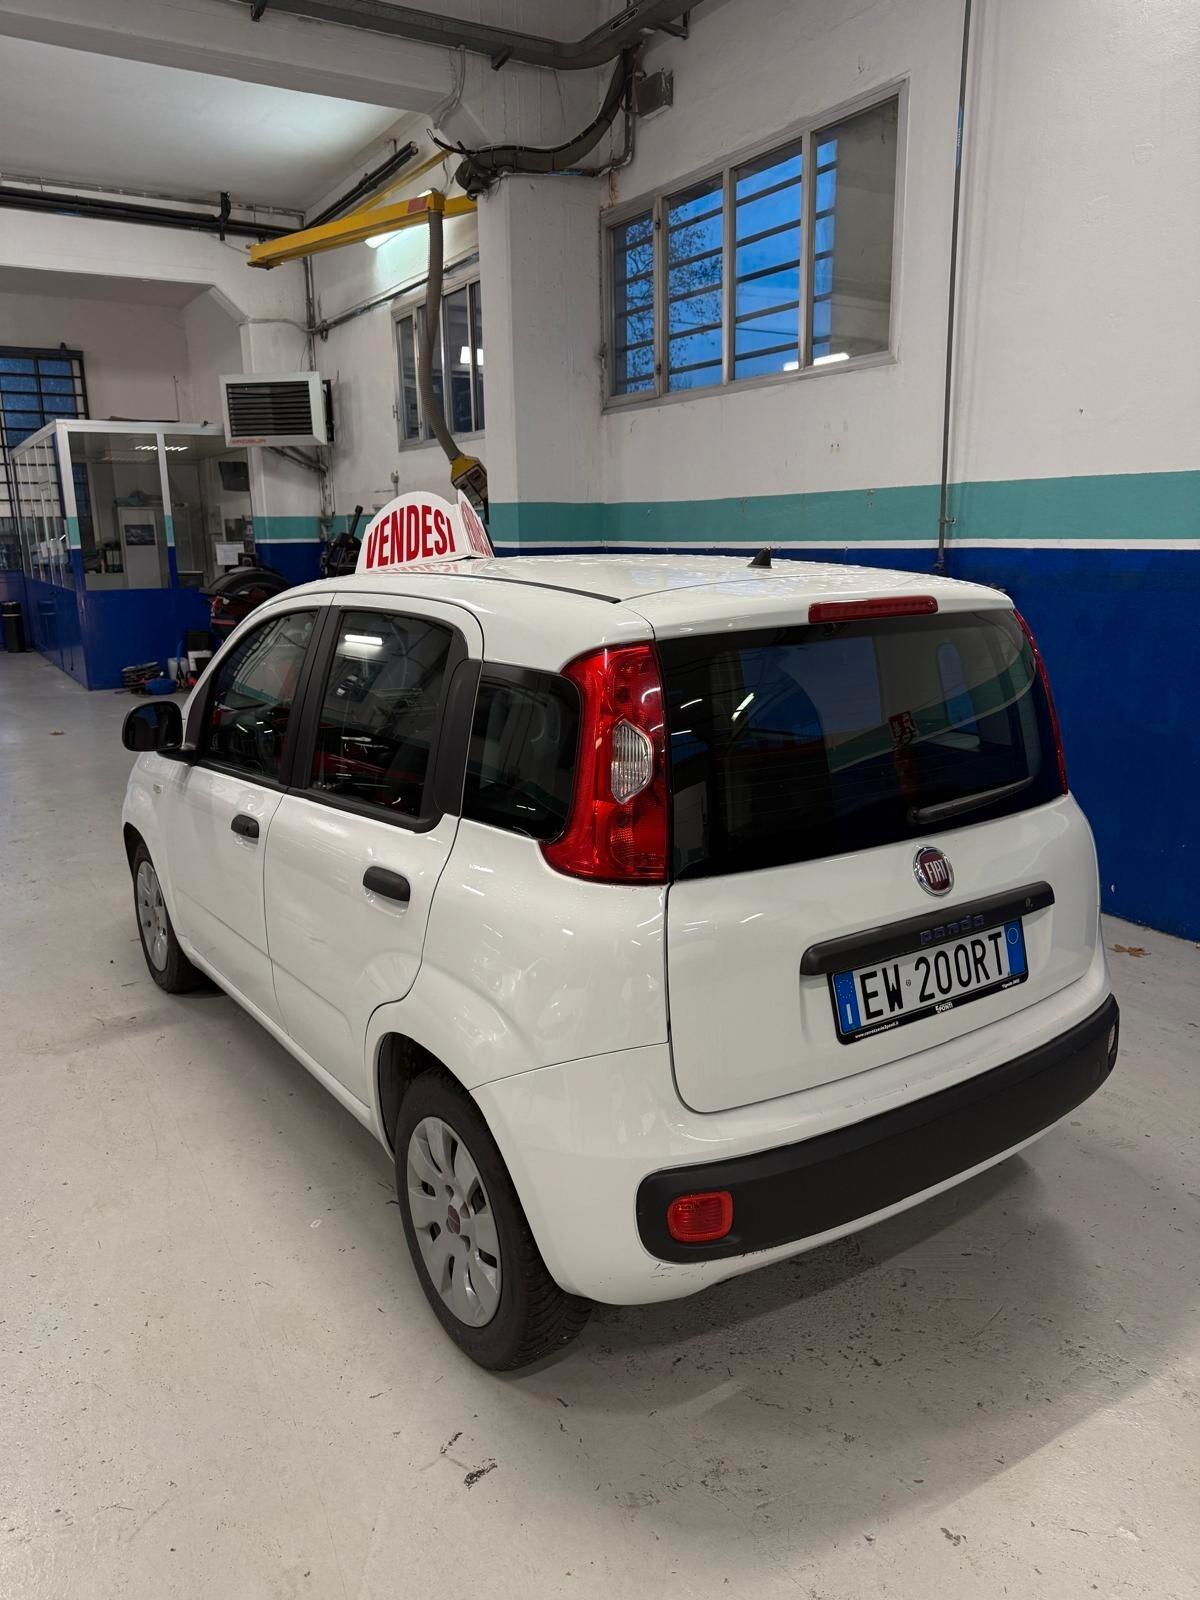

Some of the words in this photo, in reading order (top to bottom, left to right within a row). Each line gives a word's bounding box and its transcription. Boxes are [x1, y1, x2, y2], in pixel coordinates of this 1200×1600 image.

[366, 505, 456, 569] VENDESI
[924, 859, 947, 884] FIAT
[920, 914, 985, 945] panda
[860, 964, 903, 1020] EW
[914, 932, 1002, 1003] 200RT
[846, 1003, 853, 1025] I
